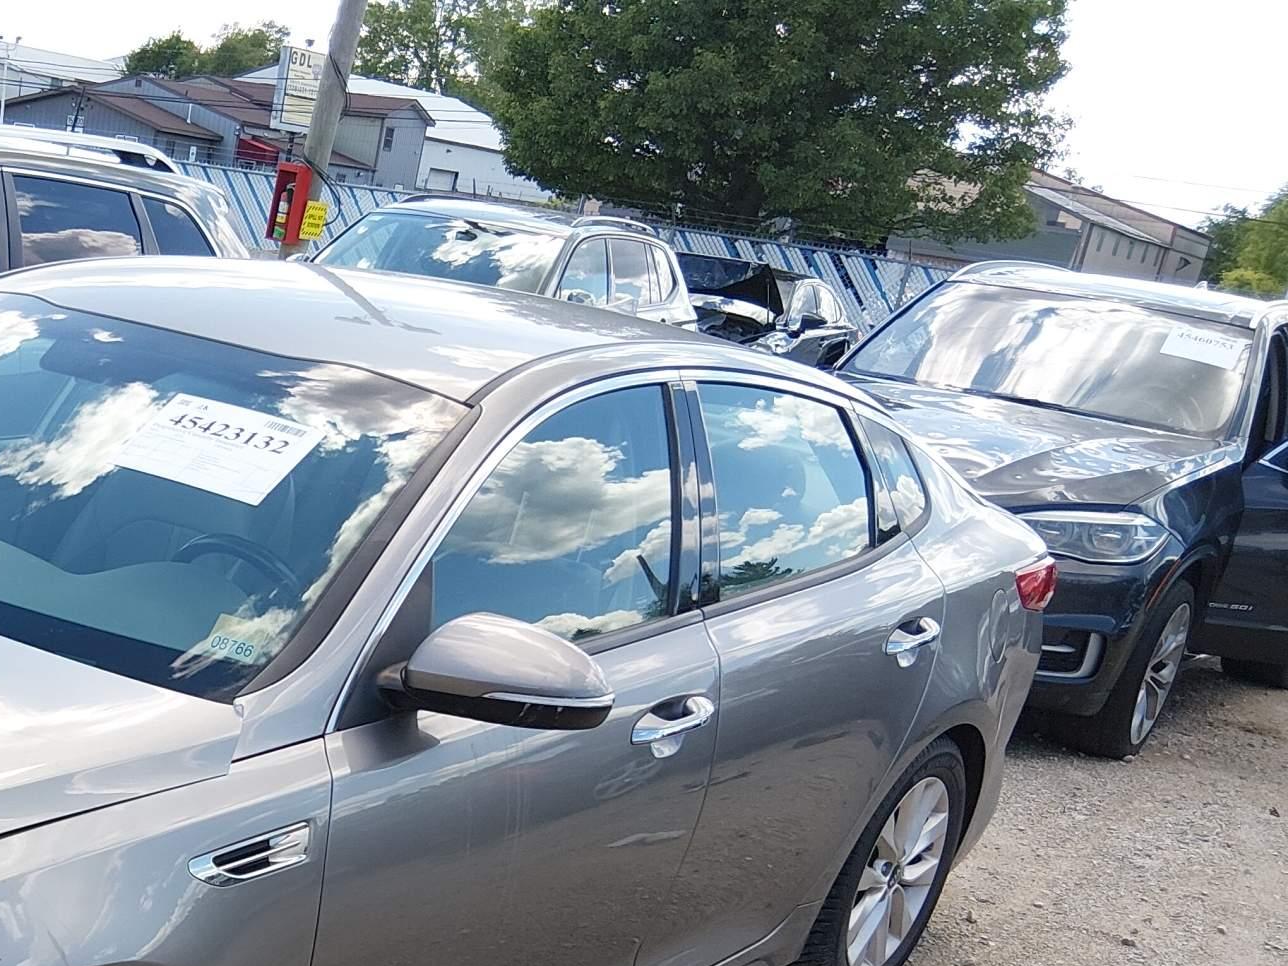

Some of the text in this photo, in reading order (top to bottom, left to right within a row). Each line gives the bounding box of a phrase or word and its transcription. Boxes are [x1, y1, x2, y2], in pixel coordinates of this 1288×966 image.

[290, 51, 312, 69] GDL
[169, 413, 290, 455] 45423132
[210, 635, 255, 658] 08766
